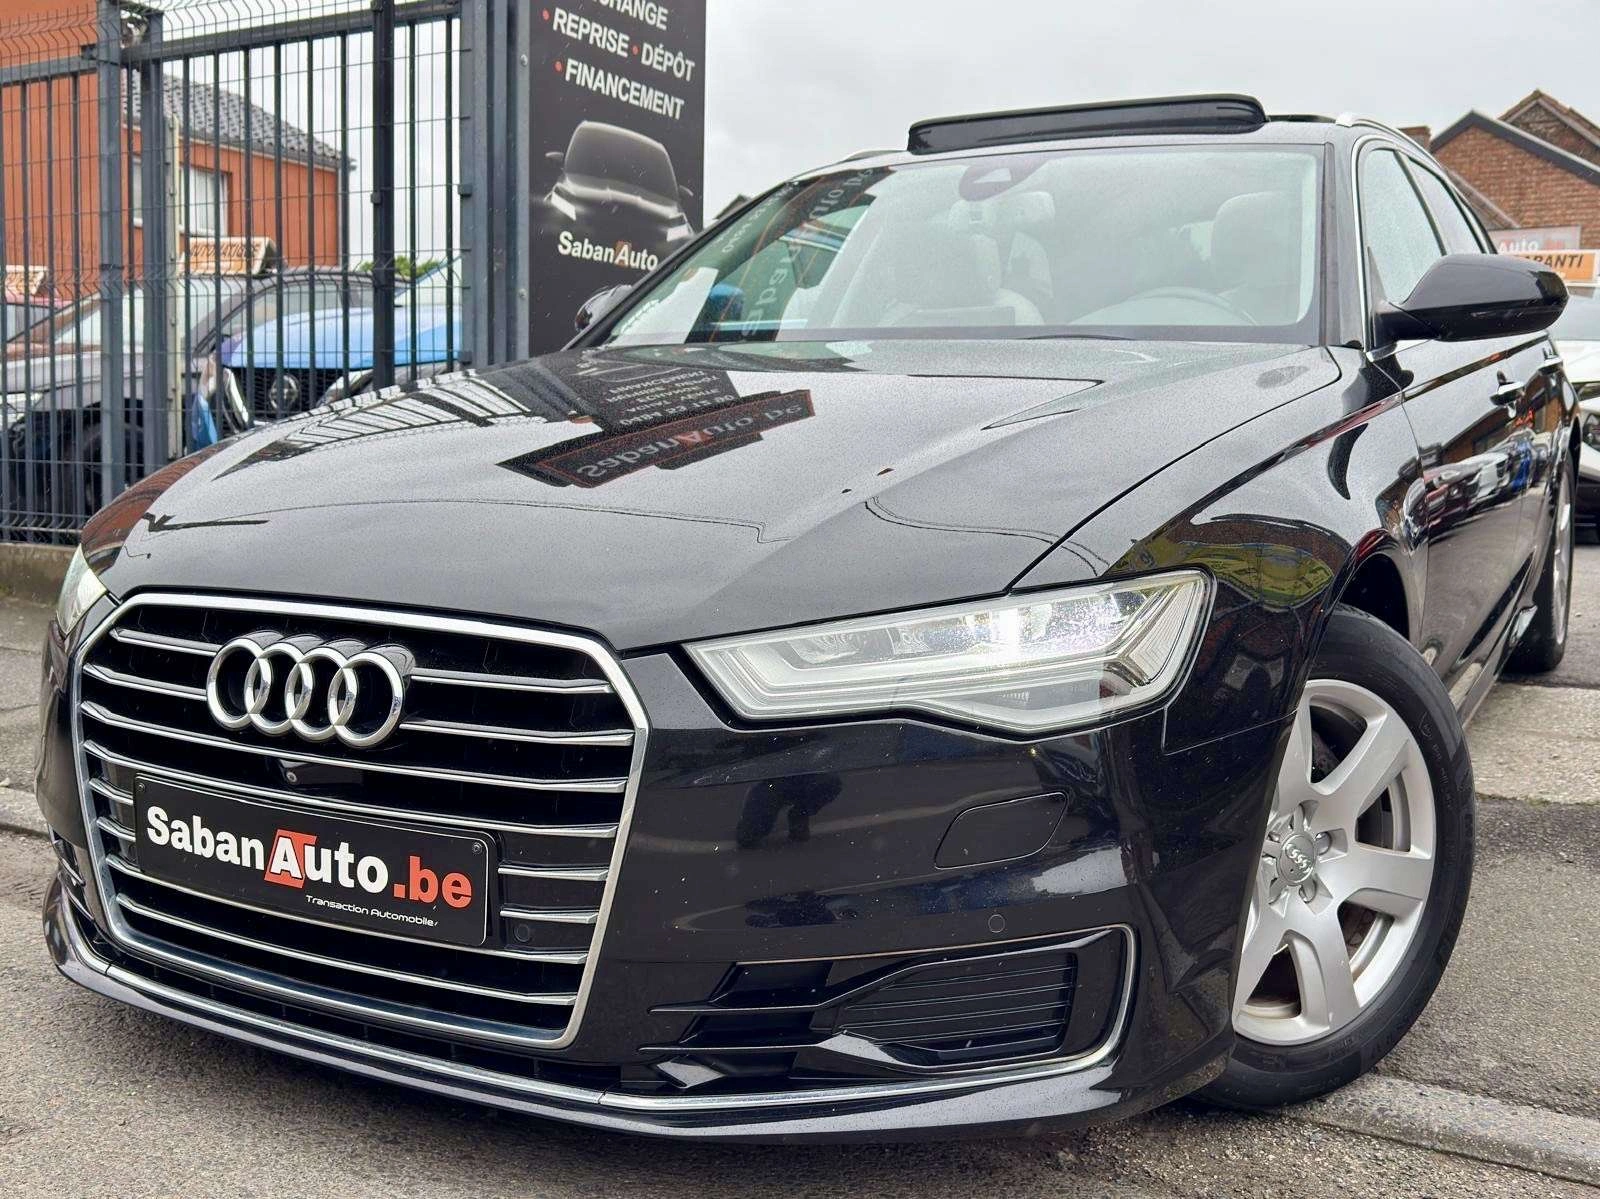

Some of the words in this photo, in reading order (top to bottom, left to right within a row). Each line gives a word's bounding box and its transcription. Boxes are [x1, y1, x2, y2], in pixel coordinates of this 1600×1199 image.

[552, 7, 630, 58] REPRISE
[641, 43, 696, 82] DÉPÔT
[565, 58, 685, 120] FINANCEMENT
[557, 231, 658, 271] SabanAuto
[147, 806, 472, 908] SabanAuto.be
[305, 895, 370, 916] Transaction
[371, 909, 434, 927] Automobile
